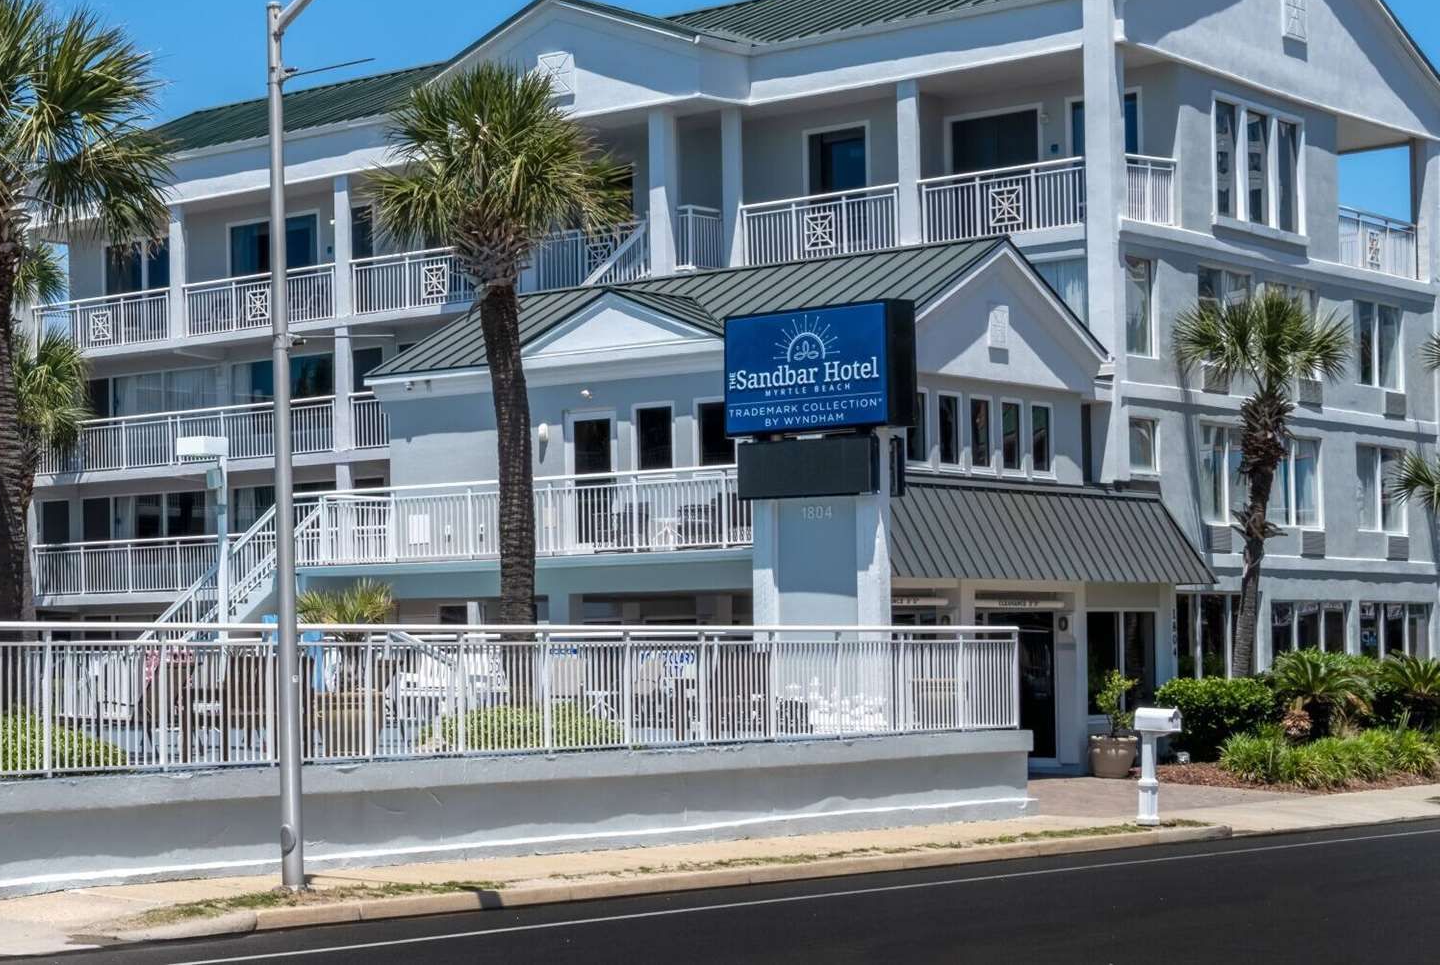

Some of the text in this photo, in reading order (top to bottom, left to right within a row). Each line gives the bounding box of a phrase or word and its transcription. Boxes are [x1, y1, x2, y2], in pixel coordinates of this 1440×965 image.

[736, 364, 818, 390] Sandbar
[824, 356, 880, 382] Hotel
[765, 383, 851, 397] MYRTLE BEACH
[729, 405, 798, 418] TRADEMARK
[765, 413, 844, 427] BY WYNDHAM
[802, 506, 832, 520] 1804
